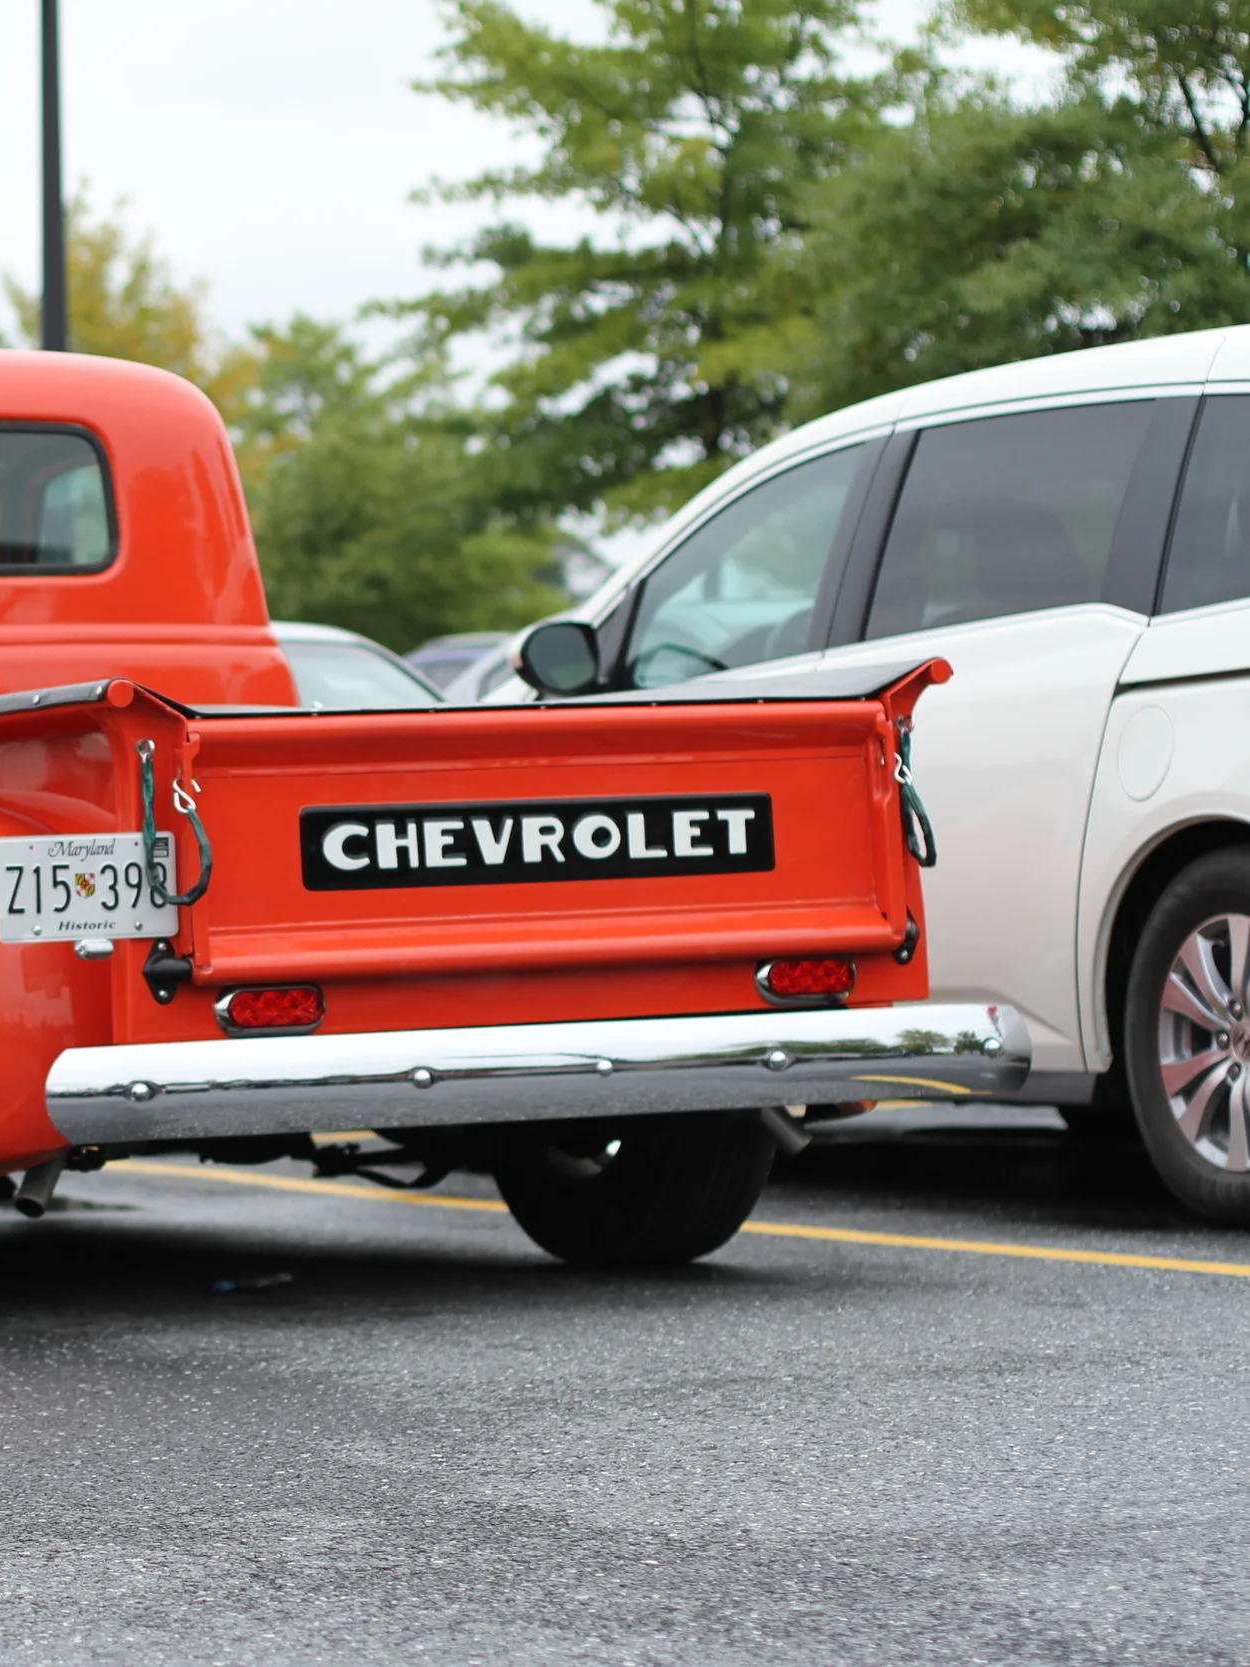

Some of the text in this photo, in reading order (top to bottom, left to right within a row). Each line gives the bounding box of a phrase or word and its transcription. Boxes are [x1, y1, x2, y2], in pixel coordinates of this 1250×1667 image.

[48, 838, 116, 861] Maryland
[322, 809, 756, 871] CHEVROLET
[6, 864, 71, 914] Z15
[58, 920, 117, 931] Historic
